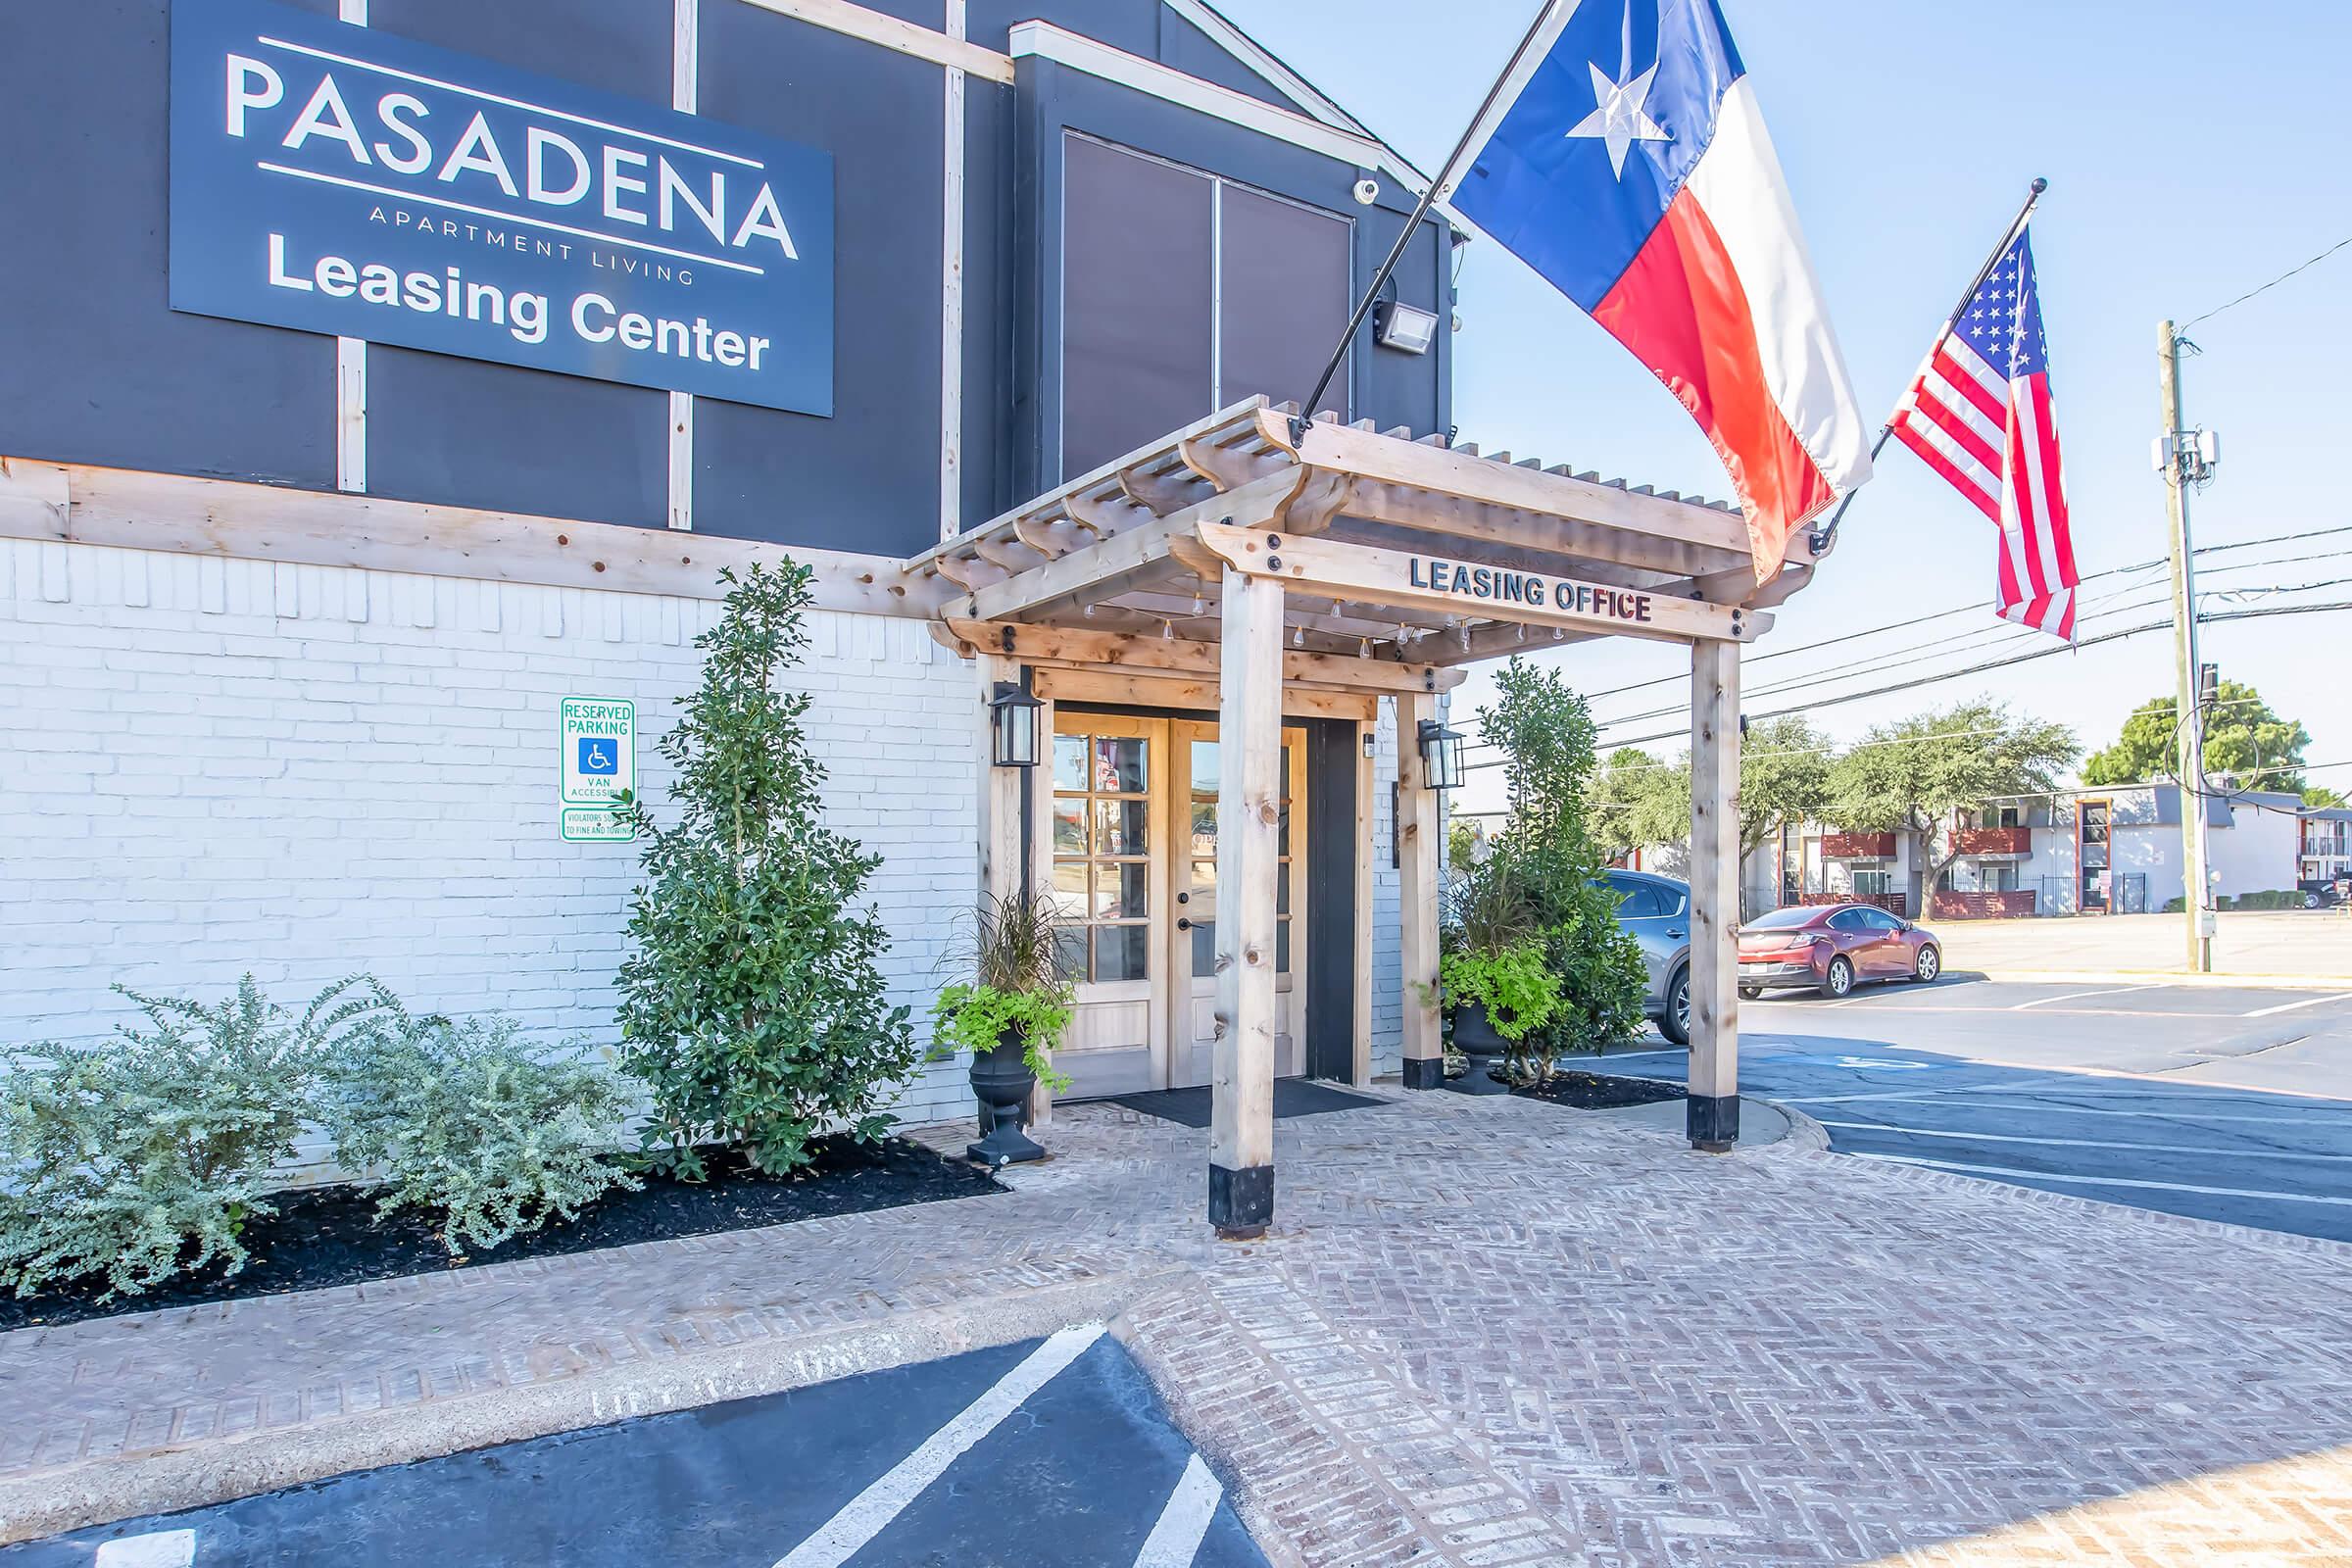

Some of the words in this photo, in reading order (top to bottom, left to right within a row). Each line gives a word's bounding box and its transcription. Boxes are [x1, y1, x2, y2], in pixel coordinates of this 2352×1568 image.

[225, 53, 800, 262] PASADENA
[368, 206, 574, 261] APARTMENT
[592, 251, 694, 286] LIVING
[268, 232, 548, 344] Leasing
[570, 292, 770, 370] Center
[1410, 558, 1544, 606] LEASING
[1555, 582, 1652, 622] OFFICE
[564, 705, 631, 720] RESERVED
[567, 720, 628, 735] PARKING
[588, 778, 611, 787] VAN
[571, 788, 625, 797] ACCESSIBL
[568, 813, 603, 822] VIOLATORS
